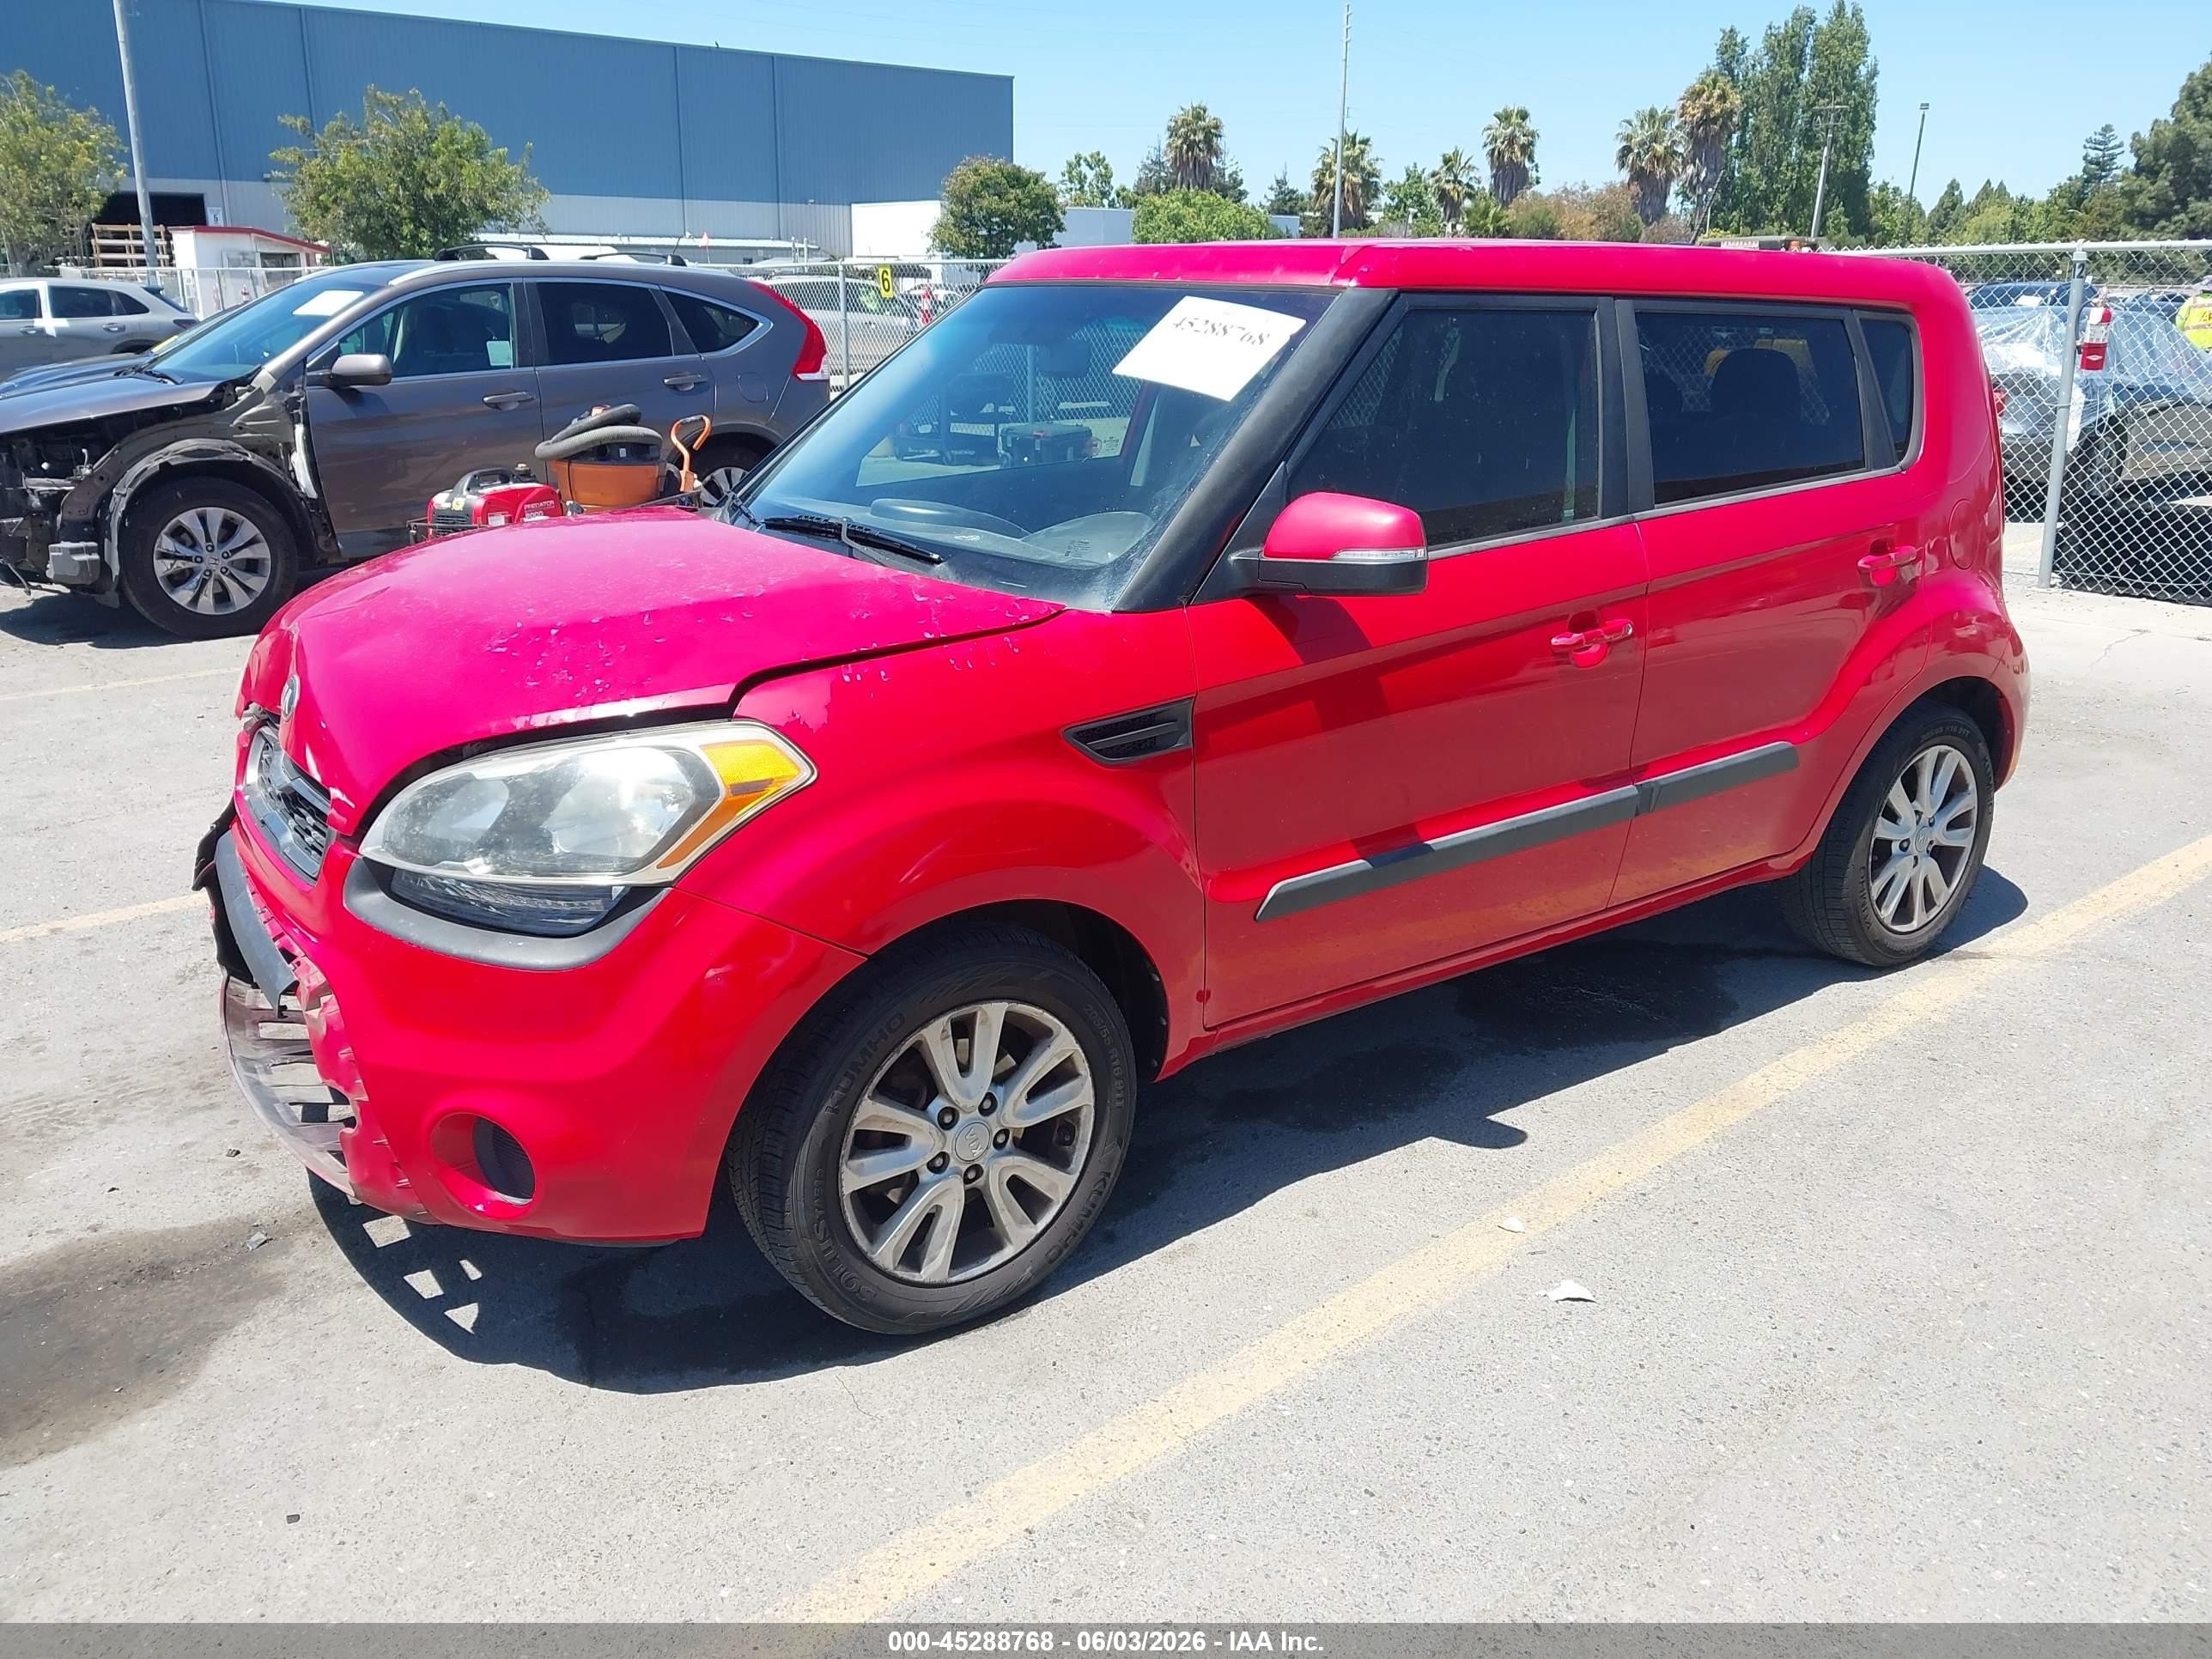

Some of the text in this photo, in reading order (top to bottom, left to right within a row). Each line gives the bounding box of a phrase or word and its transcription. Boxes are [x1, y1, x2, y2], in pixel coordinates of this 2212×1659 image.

[881, 269, 890, 293] 6
[524, 500, 555, 510] PREDATOR
[824, 1012, 906, 1115] KUMHO
[964, 1126, 984, 1158] KIA
[1045, 1170, 1112, 1265] KUMHO
[813, 1218, 878, 1302] SOLUS
